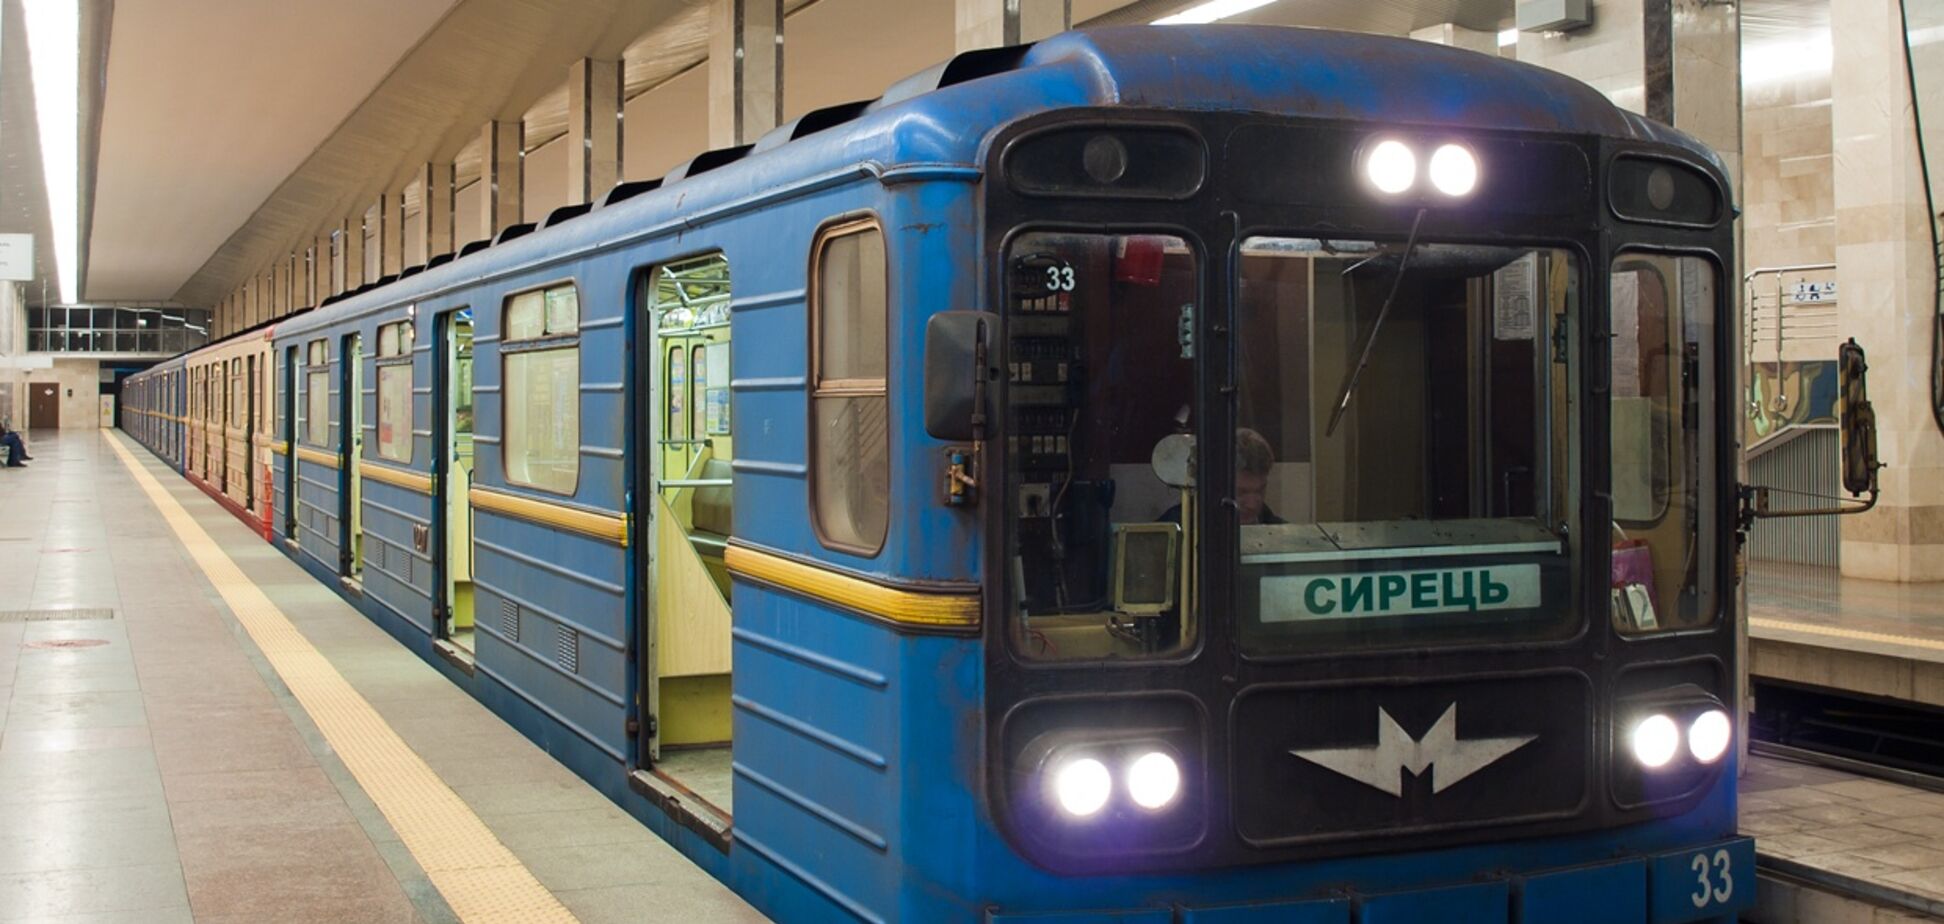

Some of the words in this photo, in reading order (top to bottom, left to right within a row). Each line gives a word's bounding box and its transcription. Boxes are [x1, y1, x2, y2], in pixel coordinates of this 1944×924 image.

[1046, 266, 1075, 291] 33
[1304, 570, 1509, 615] СИРЕЦЬ
[1691, 849, 1733, 908] 33
